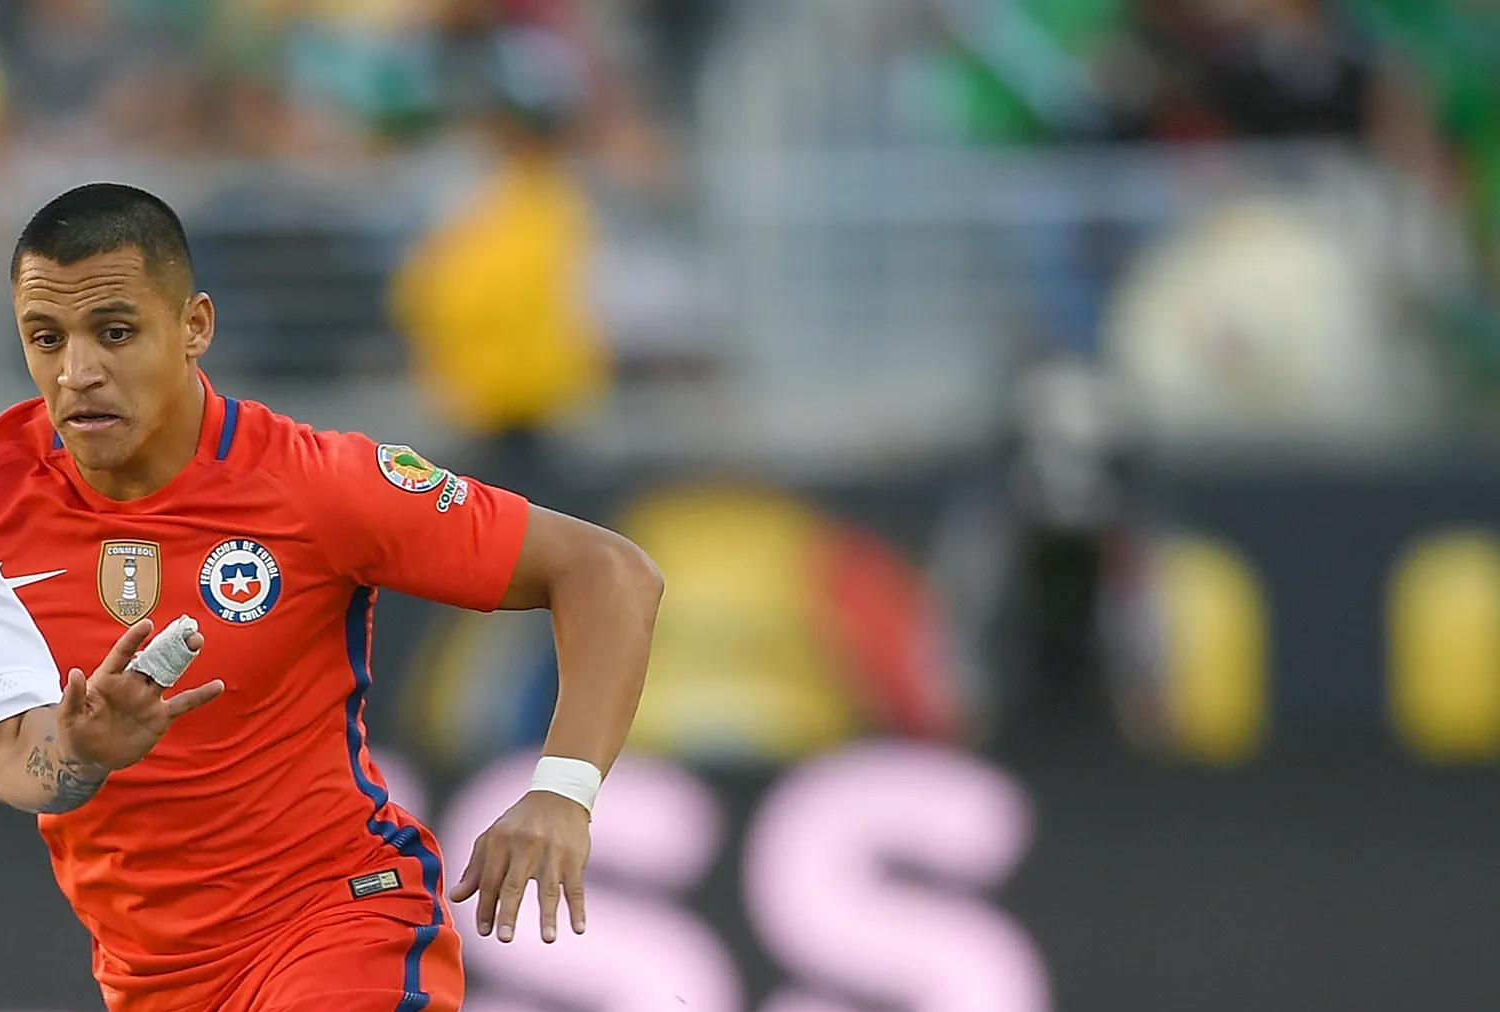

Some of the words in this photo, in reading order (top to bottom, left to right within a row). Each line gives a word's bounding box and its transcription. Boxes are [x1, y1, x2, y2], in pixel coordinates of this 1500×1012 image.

[107, 546, 155, 557] CONMEBOL
[242, 540, 255, 552] DE
[256, 547, 280, 580] FUTBOL
[221, 608, 235, 621] DE
[239, 605, 266, 622] CHILE
